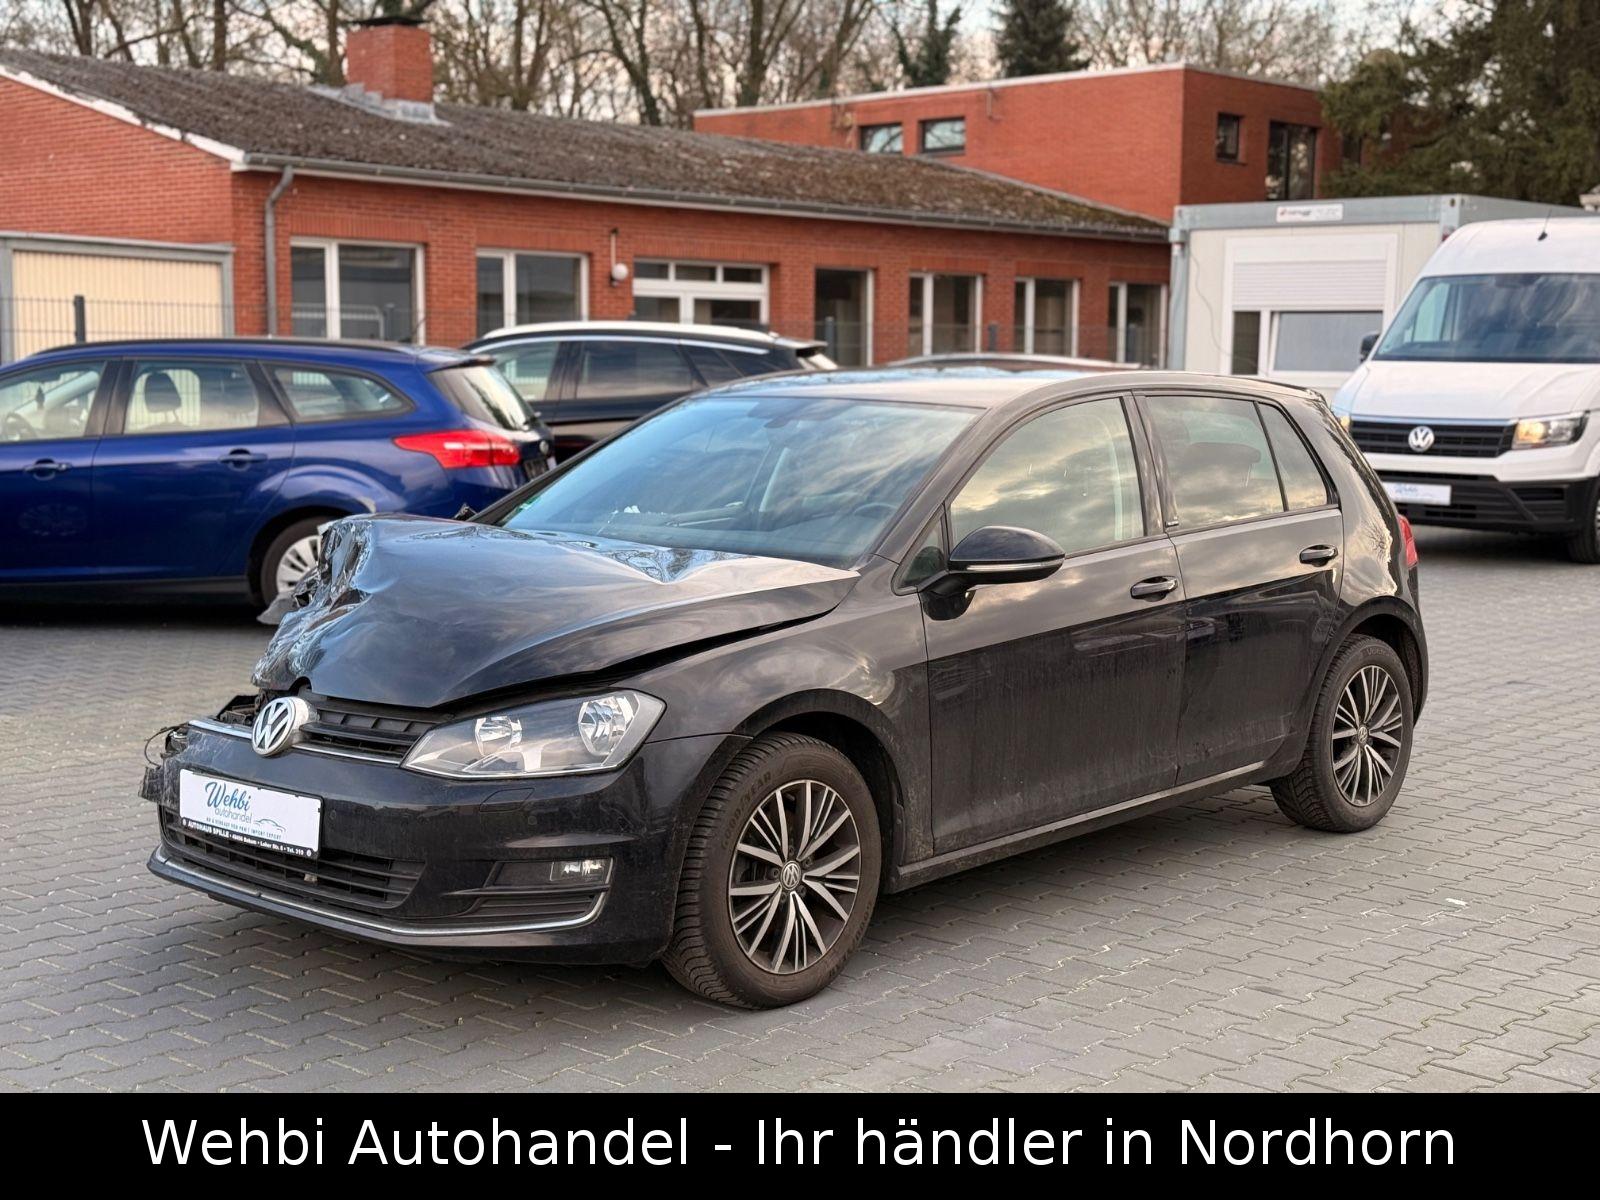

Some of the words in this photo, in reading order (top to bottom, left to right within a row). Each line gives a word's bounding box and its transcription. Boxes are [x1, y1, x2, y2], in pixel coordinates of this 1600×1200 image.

[252, 697, 296, 755] VW
[205, 781, 252, 811] Wehbi
[214, 807, 253, 824] autohandel
